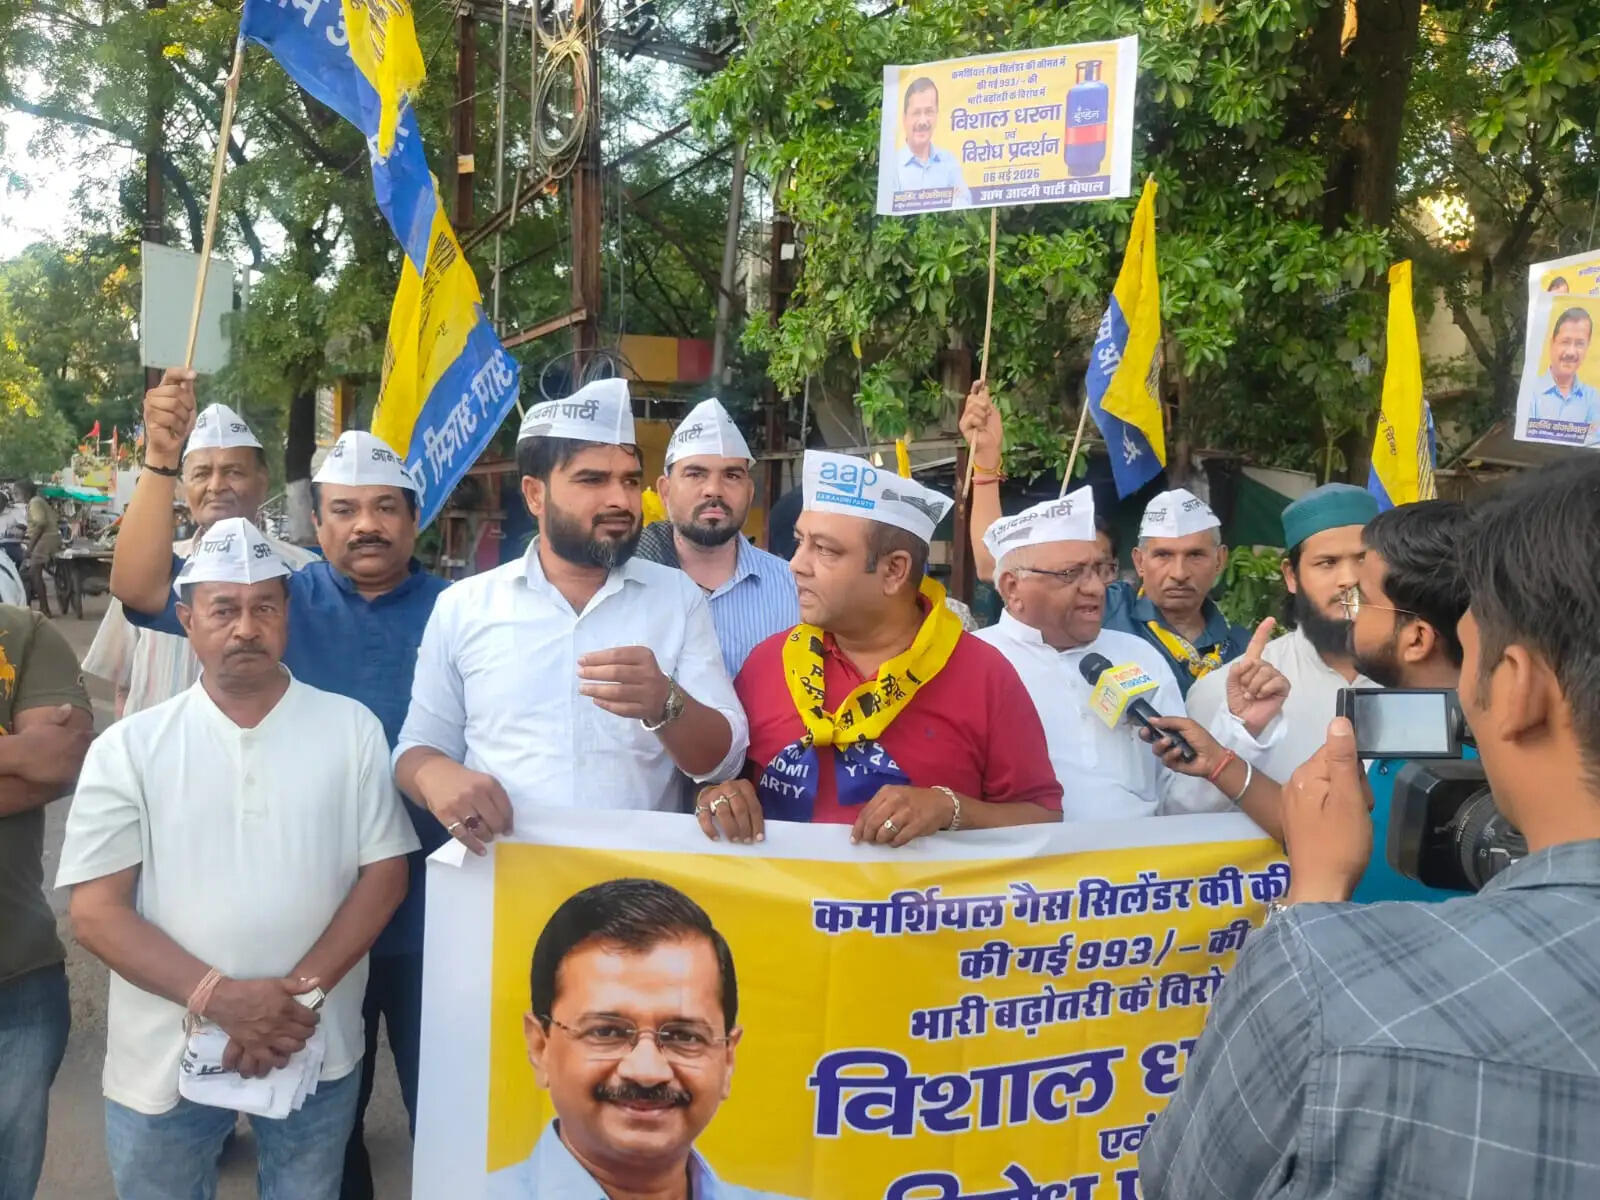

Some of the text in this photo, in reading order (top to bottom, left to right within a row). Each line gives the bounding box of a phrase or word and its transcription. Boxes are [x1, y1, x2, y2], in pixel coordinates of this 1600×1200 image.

[1028, 73, 1038, 84] की
[951, 103, 1063, 131] विशाल धरना
[962, 133, 1061, 163] विरोध प्रदर्शन
[999, 168, 1012, 182] मई
[1013, 168, 1040, 181] 2026
[980, 180, 1104, 201] आम आदमी पार्टी भोपाल
[561, 399, 600, 421] पार्टी
[678, 423, 703, 443] पार्टी
[819, 461, 877, 498] aap
[204, 533, 236, 553] पार्टी
[760, 774, 806, 800] ARTY
[813, 862, 1291, 934] कमर्शियल गैस सिलेंडर की की
[959, 941, 1013, 979] की
[1017, 934, 1074, 976] गई
[1209, 918, 1251, 954] की
[911, 966, 1225, 1040] भारी बढ़ोतरी के विरो
[808, 1048, 1125, 1138] विशाल
